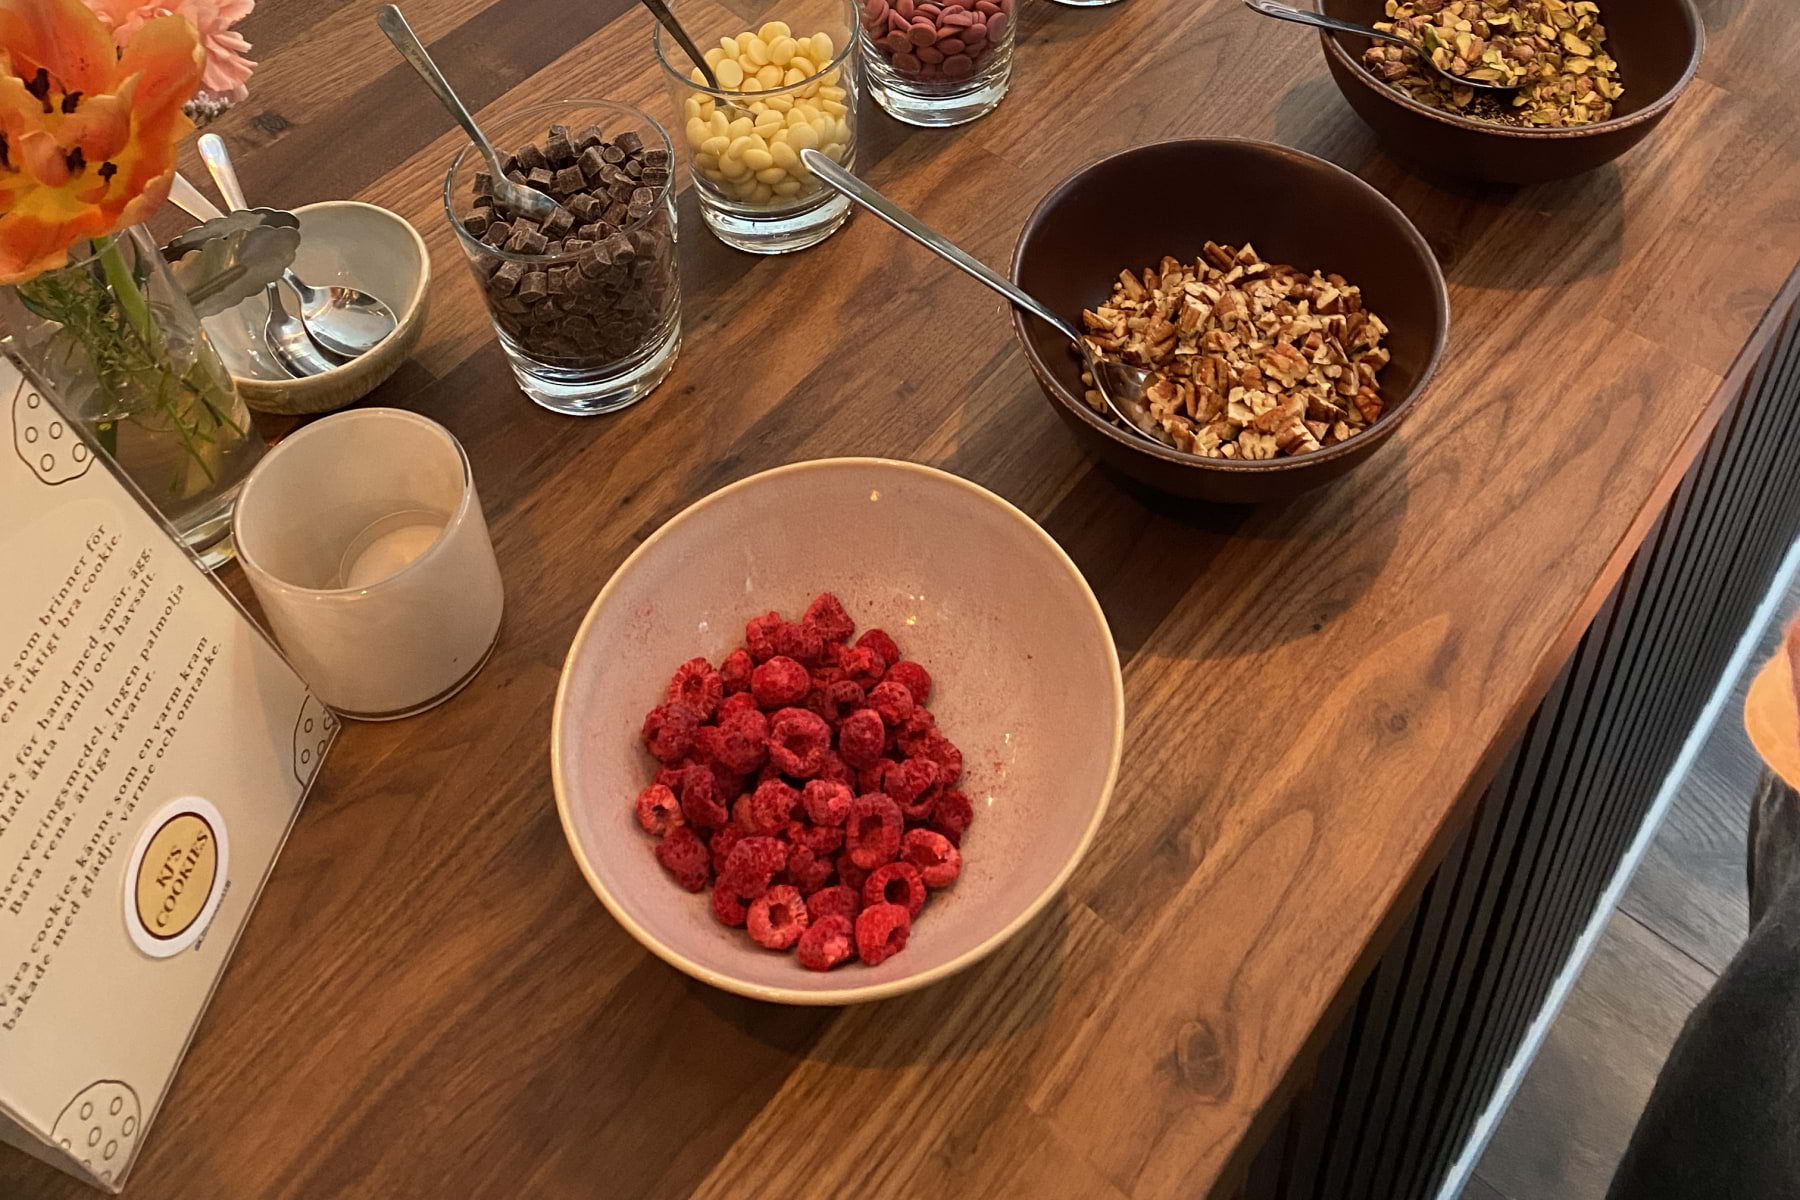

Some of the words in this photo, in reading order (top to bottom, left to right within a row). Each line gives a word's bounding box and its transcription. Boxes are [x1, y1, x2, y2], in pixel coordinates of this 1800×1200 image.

[1, 701, 18, 723] en
[19, 633, 59, 693] riktigt
[58, 599, 82, 628] bra
[82, 534, 121, 593] cookie.
[14, 632, 40, 670] som
[39, 556, 87, 626] brinner
[86, 525, 105, 552] för
[16, 736, 38, 765] för
[37, 681, 72, 730] hand
[72, 635, 100, 677] med
[99, 585, 133, 633] smör,
[129, 548, 152, 579] ägg,
[29, 738, 57, 780] äkta
[57, 677, 94, 731] vanilj
[94, 642, 115, 673] och
[113, 572, 156, 636] havsalt.
[105, 666, 140, 716] Ingen
[140, 585, 183, 662] palmolja
[2, 952, 50, 1031] bakade
[53, 901, 80, 946] med
[81, 832, 121, 898] glädje,
[120, 764, 155, 821] värme
[156, 727, 176, 758] och
[177, 642, 222, 720] omtanke.
[9, 868, 42, 915] Bara
[43, 813, 75, 860] rena,
[75, 746, 111, 803] ärliga
[111, 670, 156, 741] råvaror.
[31, 876, 77, 953] cookies
[75, 811, 113, 868] känns
[114, 766, 138, 804] som
[139, 738, 153, 759] en
[153, 687, 182, 730] varm
[180, 637, 208, 681] kram
[155, 831, 209, 928] COOKIES
